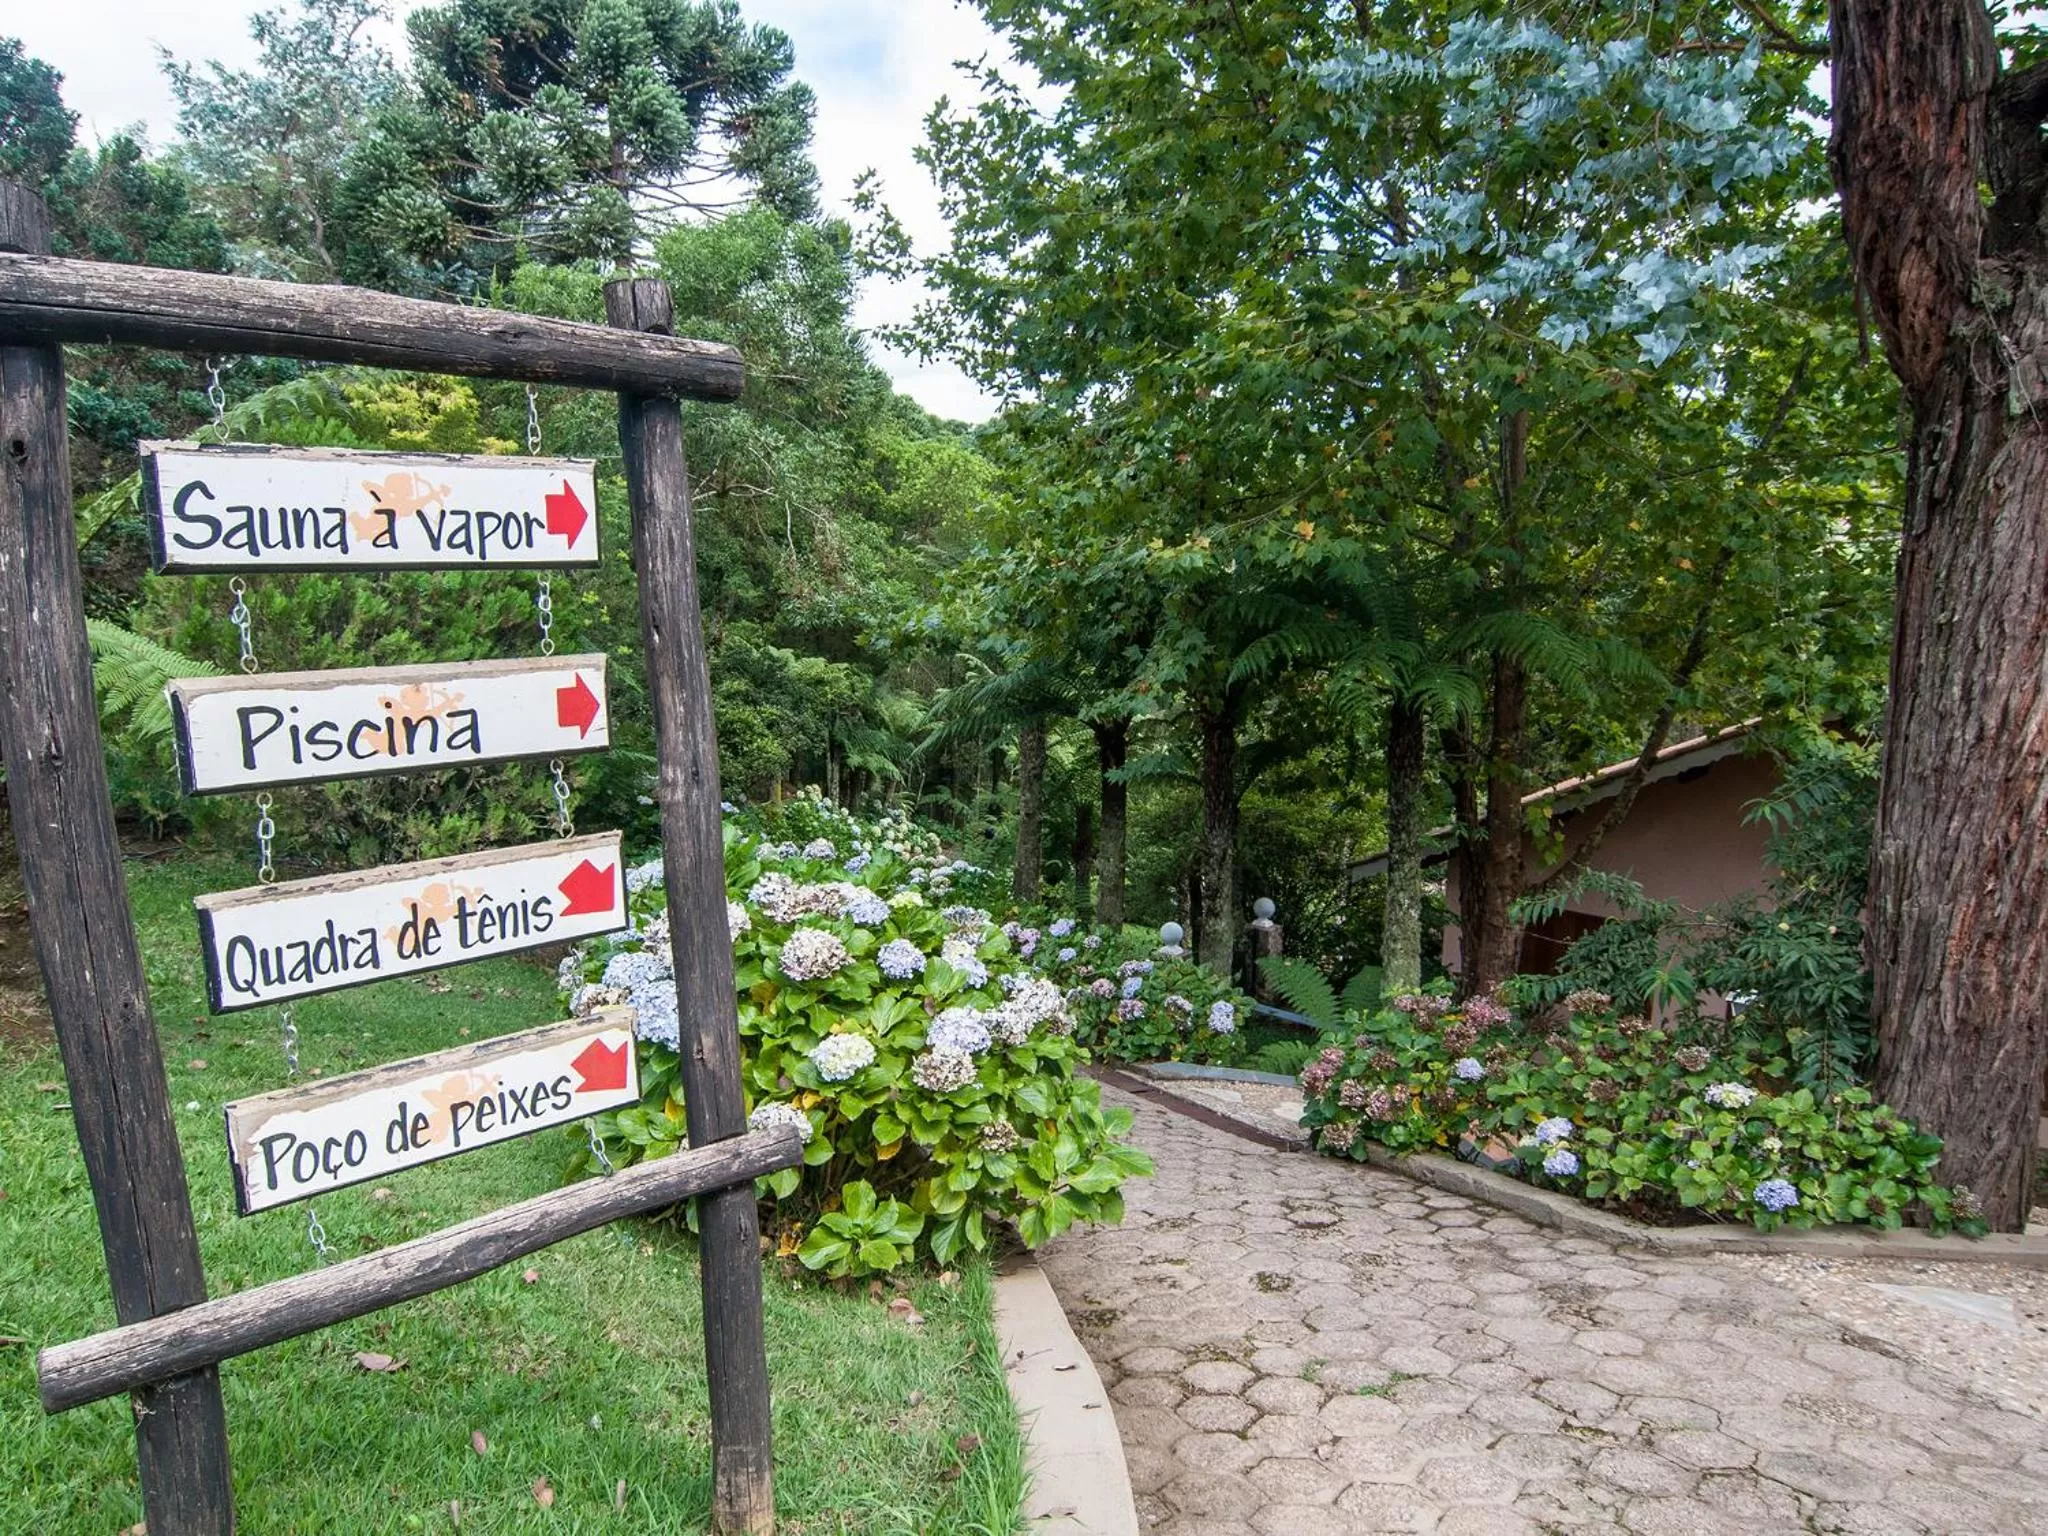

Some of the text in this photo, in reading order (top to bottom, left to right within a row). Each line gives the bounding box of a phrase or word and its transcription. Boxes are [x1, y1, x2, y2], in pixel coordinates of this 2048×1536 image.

[173, 480, 545, 560] Sauna à vapor
[236, 705, 481, 770] Piscina
[226, 888, 554, 997] Quadra de tênis
[259, 1075, 572, 1190] Poço de peixes
